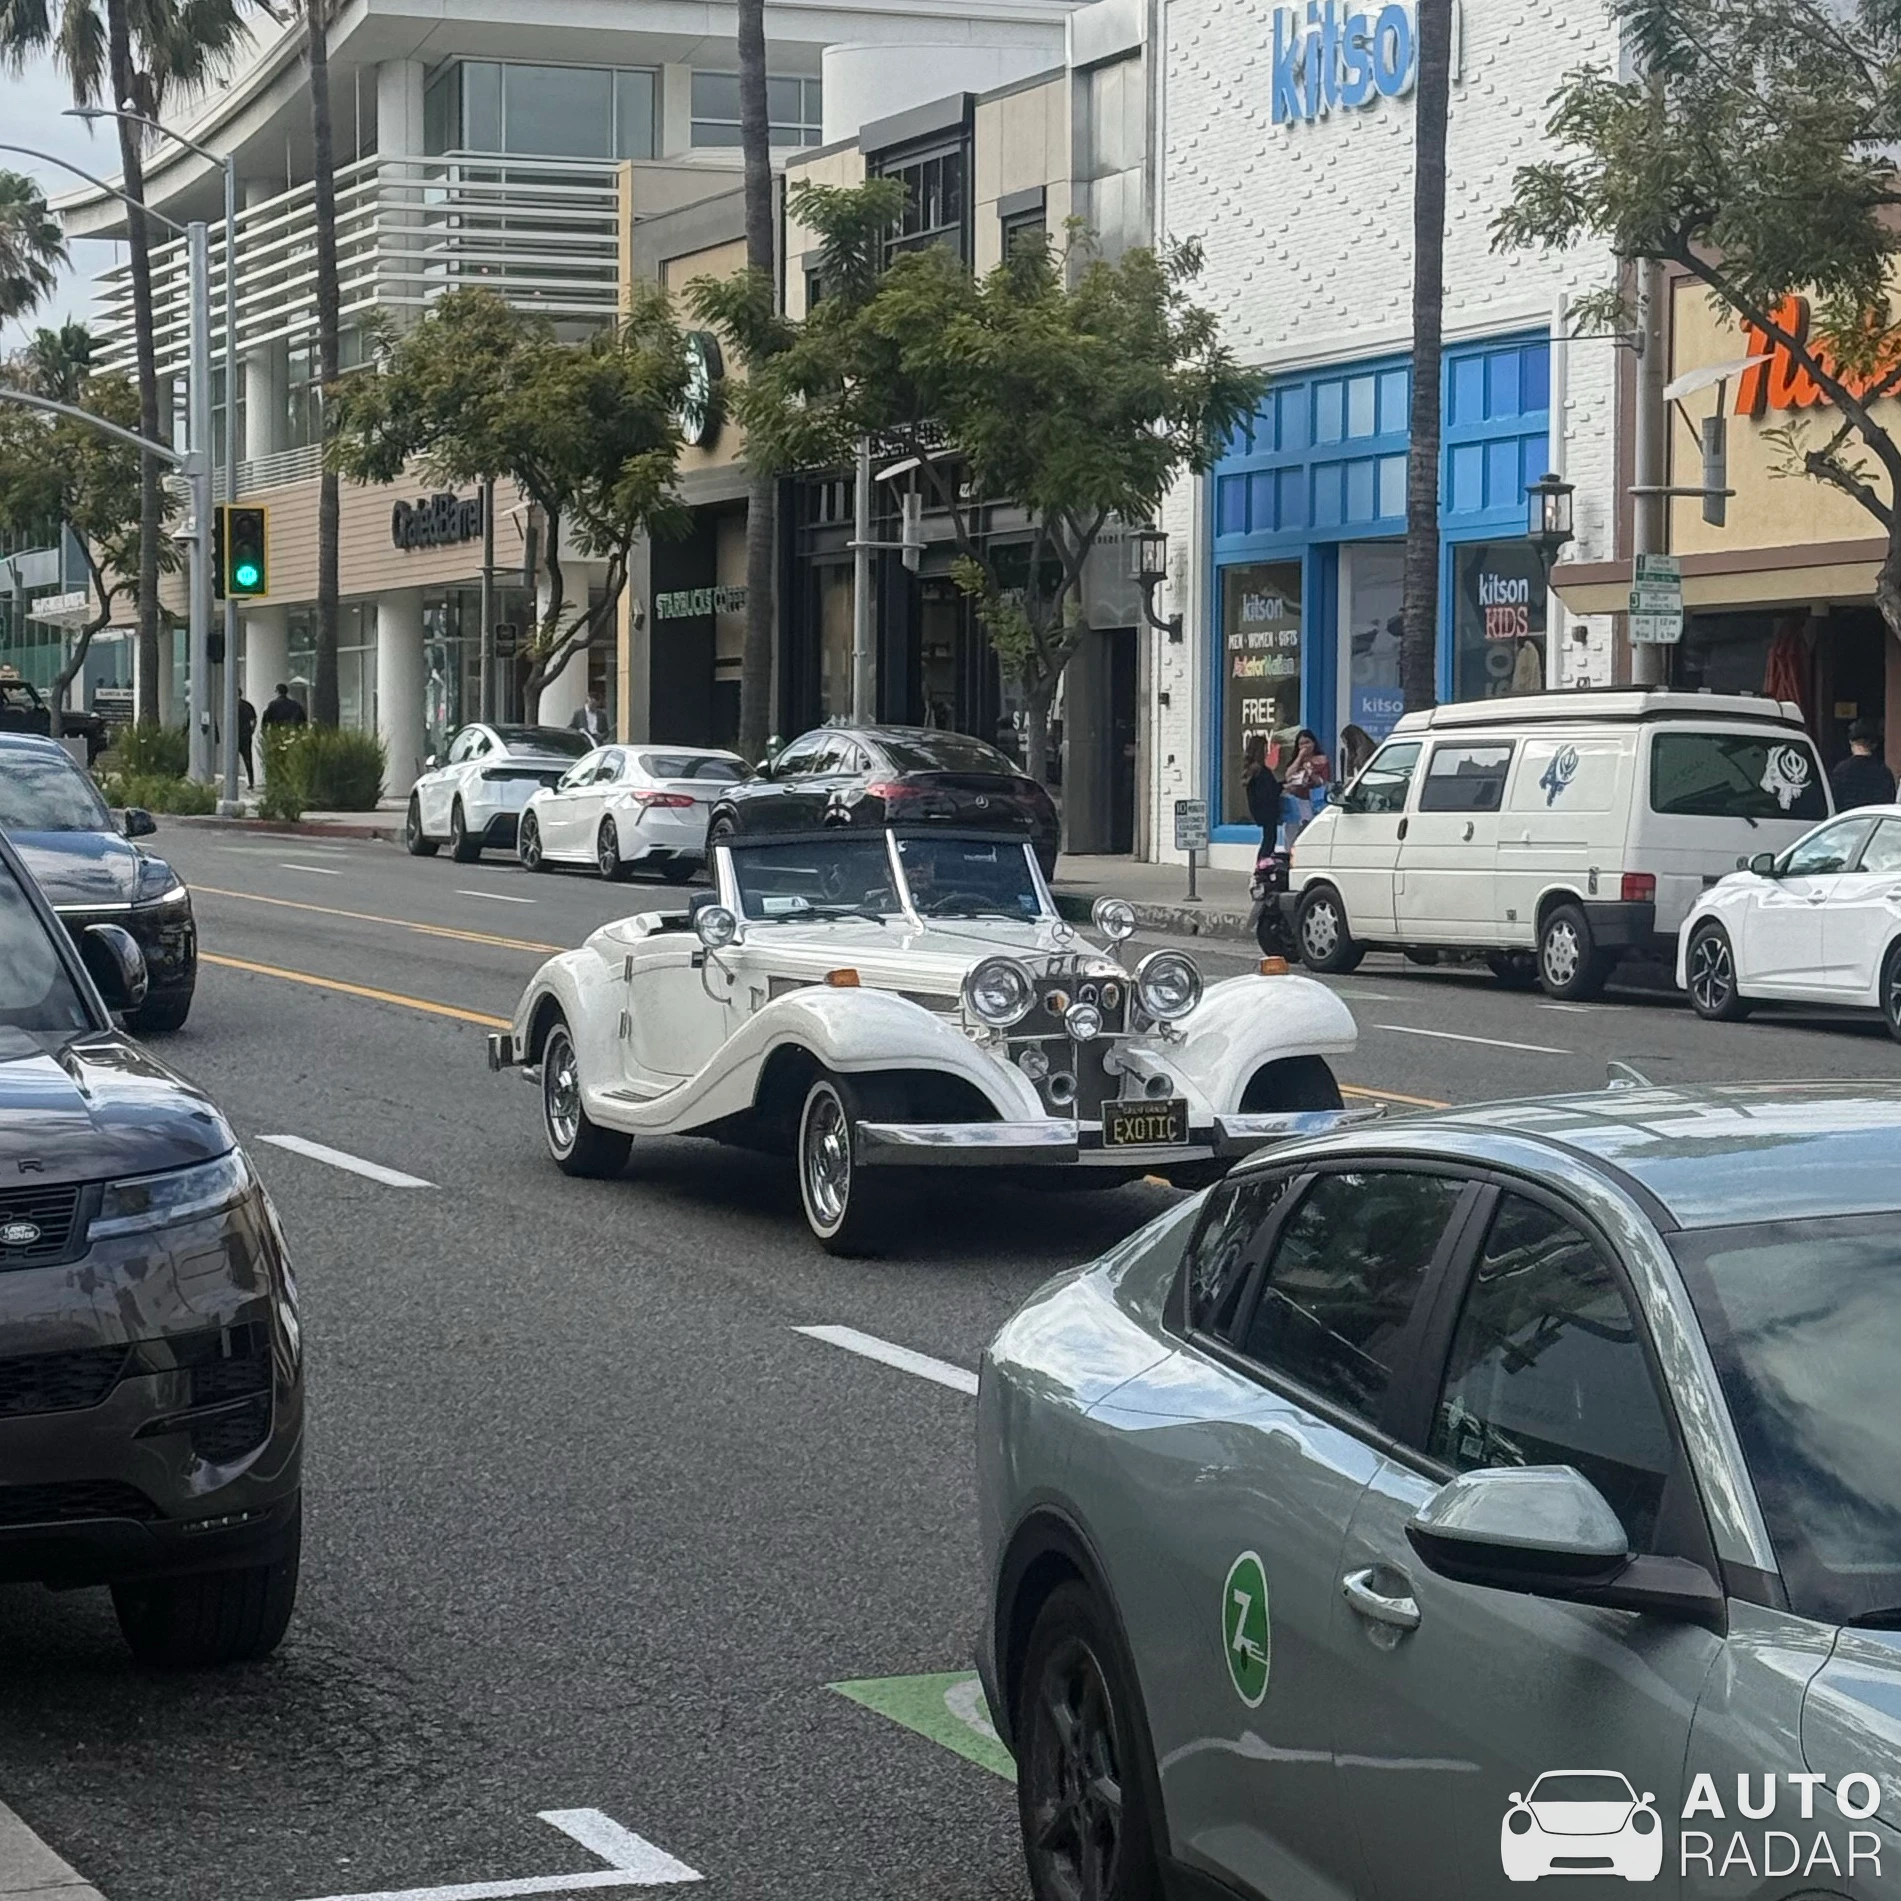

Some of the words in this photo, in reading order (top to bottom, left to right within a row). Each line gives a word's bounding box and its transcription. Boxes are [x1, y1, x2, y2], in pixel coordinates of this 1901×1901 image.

[1271, 0, 1459, 125] kitso
[1478, 573, 1529, 606] kitson
[1242, 593, 1283, 622] kitson
[1484, 606, 1529, 639] KIDS
[1228, 634, 1243, 650] MEN
[1248, 632, 1273, 648] WOMEN
[1242, 698, 1275, 724] FREE
[1362, 698, 1404, 712] kitso
[1242, 729, 1274, 754] CY
[1114, 1116, 1177, 1143] EXOTIC
